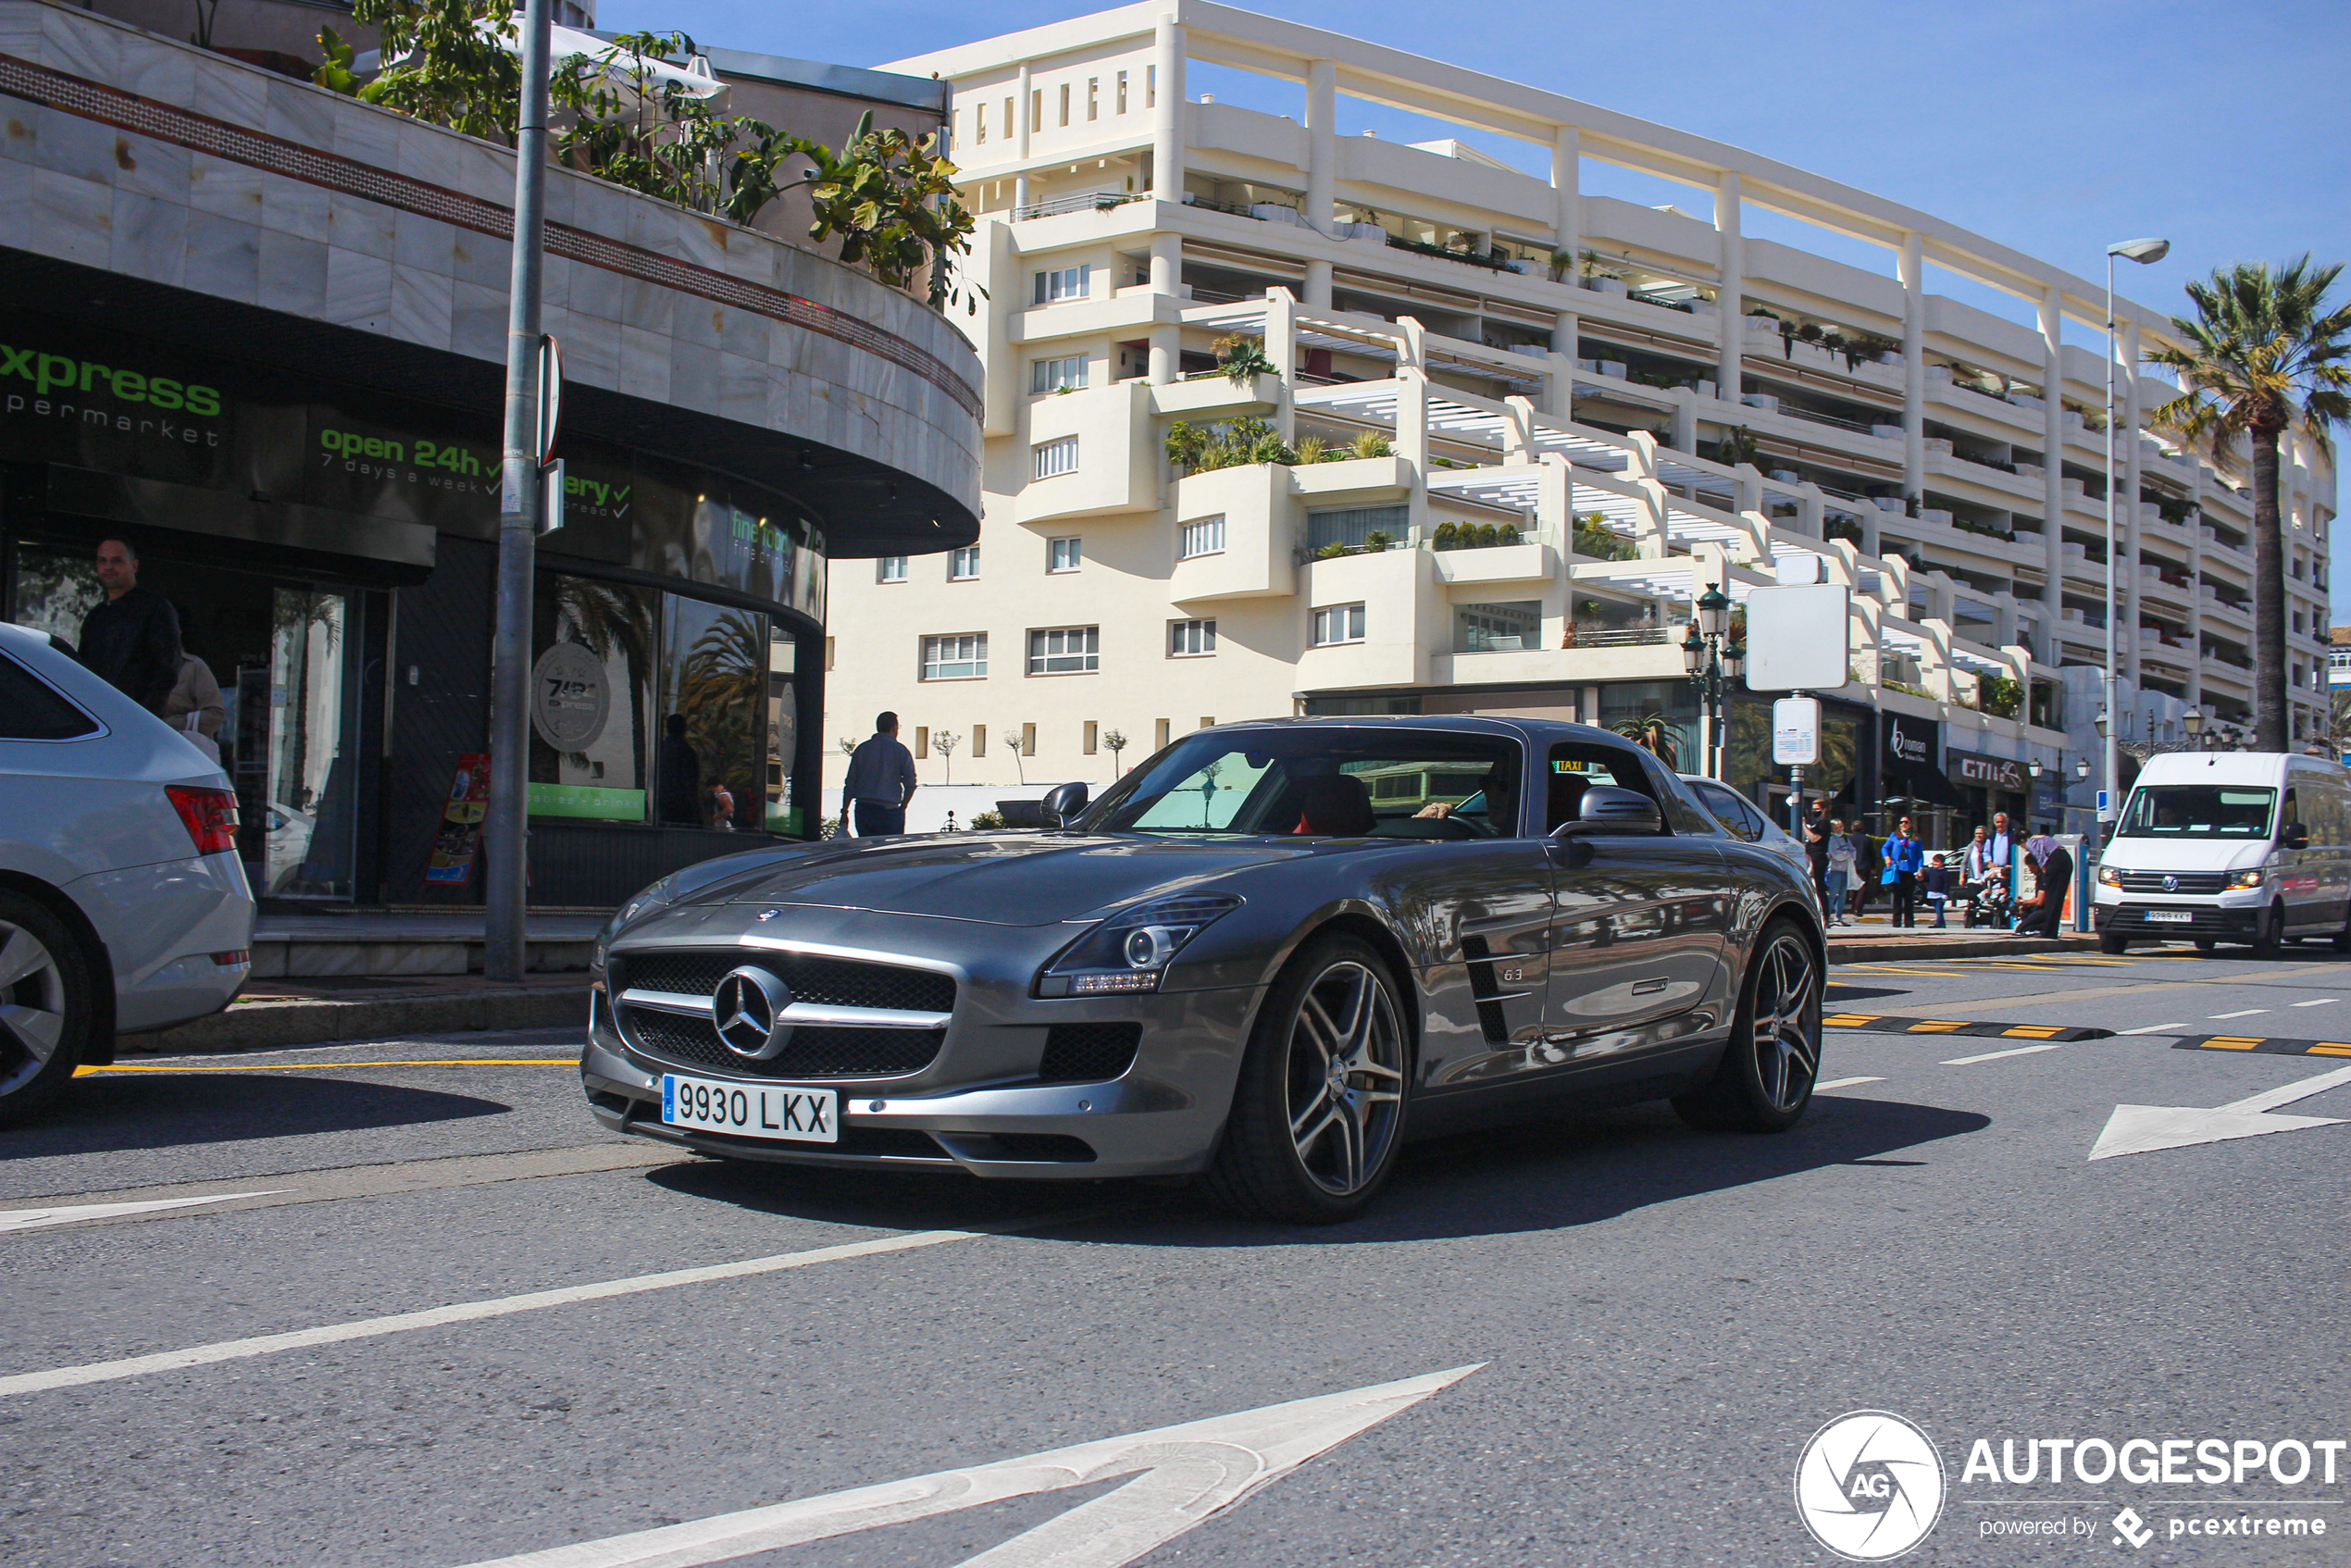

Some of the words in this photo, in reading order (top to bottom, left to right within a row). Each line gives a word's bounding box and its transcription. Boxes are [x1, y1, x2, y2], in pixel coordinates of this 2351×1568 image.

[0, 343, 220, 417] xpress
[6, 393, 218, 447] permarket
[321, 429, 404, 462] open
[414, 440, 479, 477] 24h
[321, 453, 332, 467] 7
[345, 459, 396, 479] days
[407, 472, 417, 483] a
[429, 476, 478, 493] week
[733, 510, 758, 543] fine
[548, 699, 595, 711] express
[1560, 760, 1582, 771] TAXI
[1504, 968, 1523, 981] 6.3
[680, 1082, 748, 1126] 9930
[761, 1091, 827, 1134] LKX
